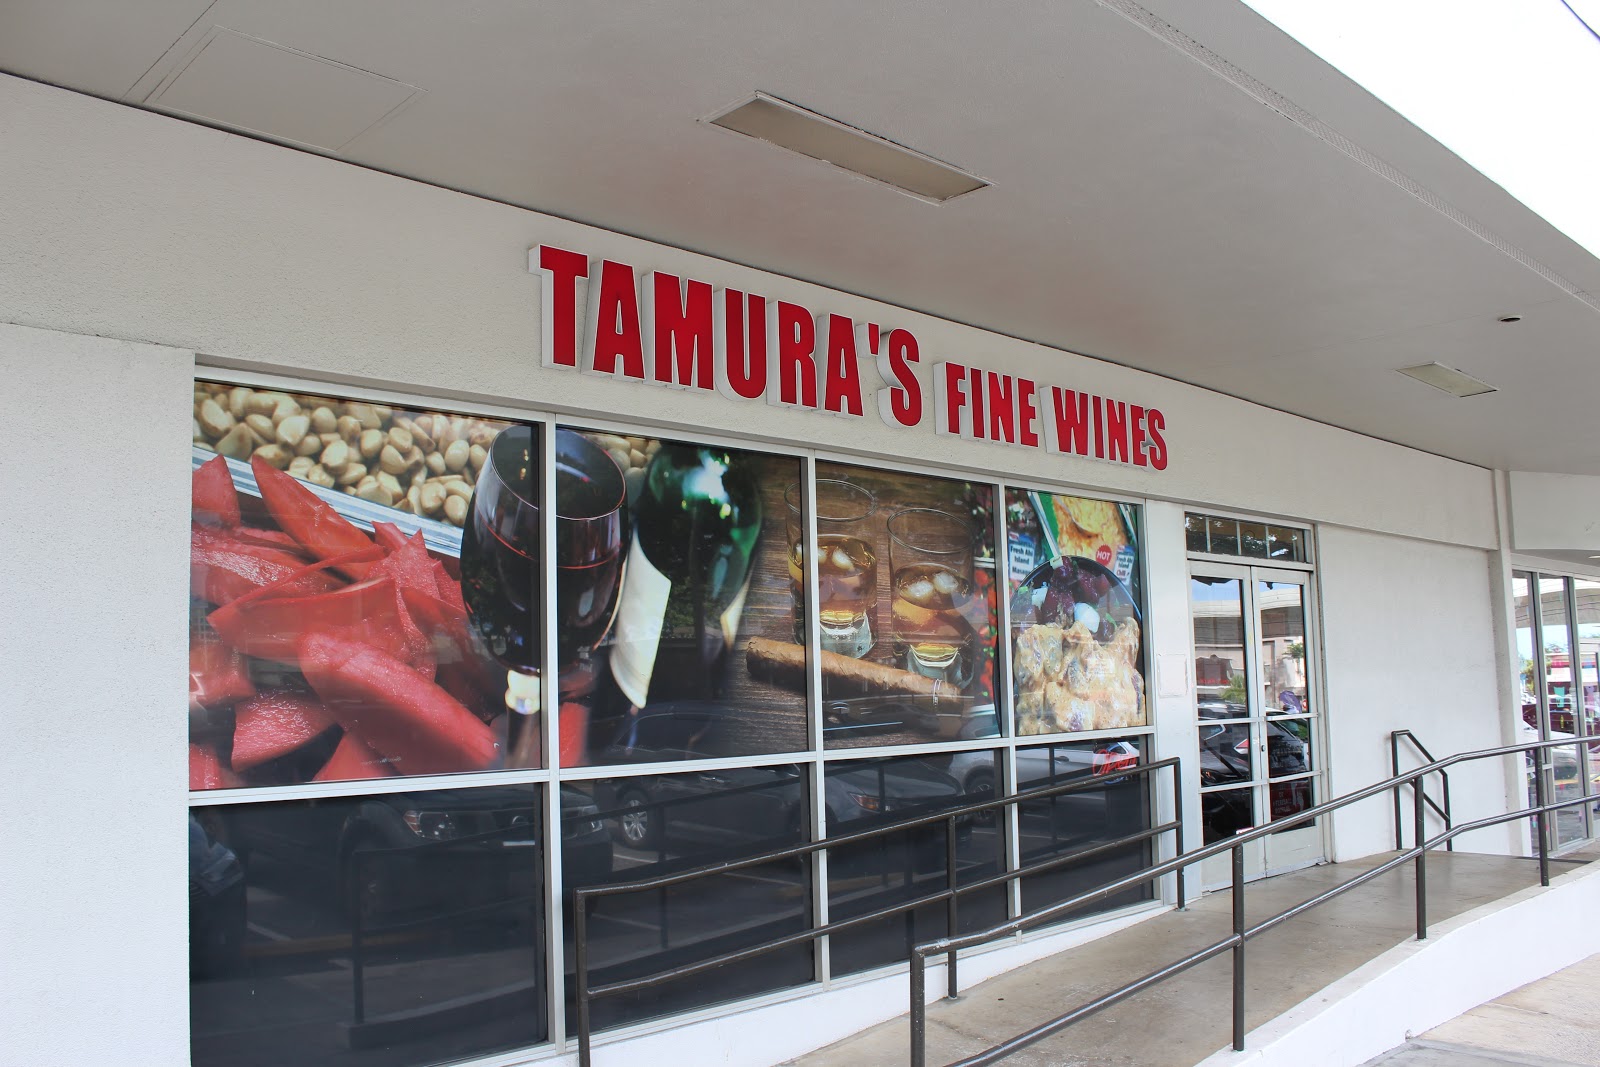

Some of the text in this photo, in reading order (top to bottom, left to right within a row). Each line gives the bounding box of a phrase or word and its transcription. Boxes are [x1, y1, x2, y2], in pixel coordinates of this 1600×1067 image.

[537, 244, 1168, 471] TAMURA'S FINE WINES
[1014, 555, 1030, 566] Island
[1096, 549, 1111, 561] HOT
